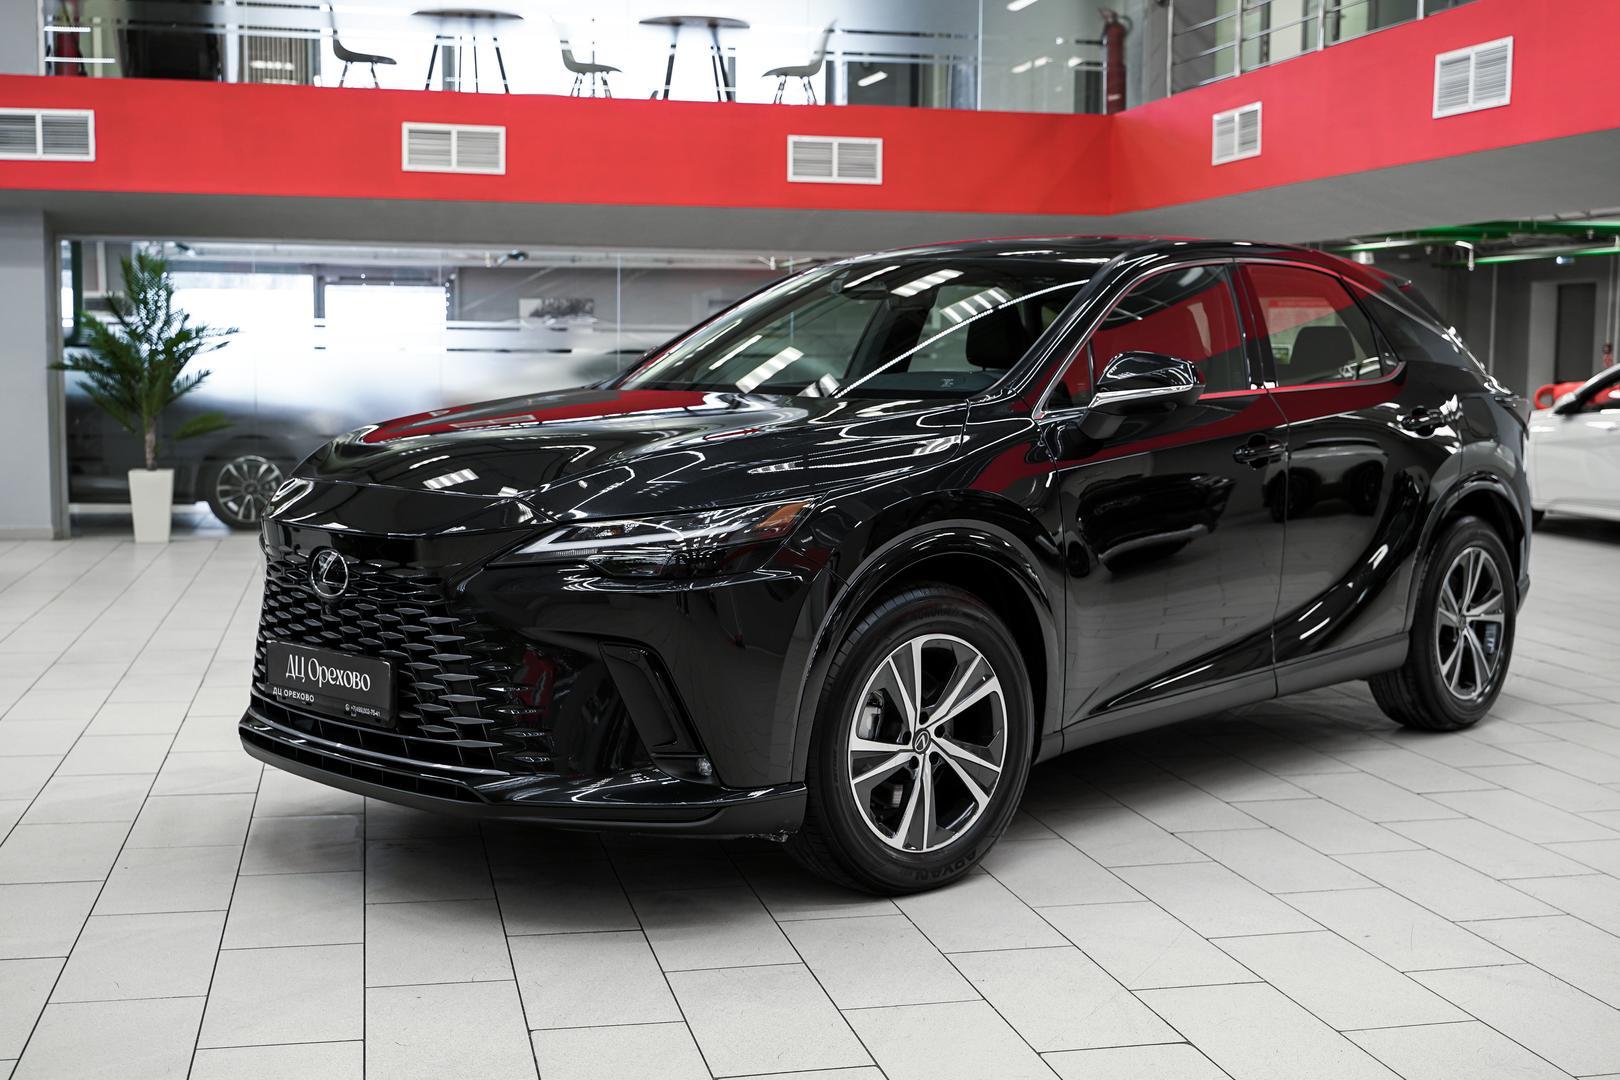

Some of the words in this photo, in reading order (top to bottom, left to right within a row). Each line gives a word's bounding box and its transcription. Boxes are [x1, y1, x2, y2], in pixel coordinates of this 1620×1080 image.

[285, 654, 306, 683] ДЦ
[308, 658, 371, 692] Орехово
[272, 686, 283, 697] ДЦ
[283, 689, 315, 703] ОРЕХОВО
[914, 849, 977, 881] ADVAN
